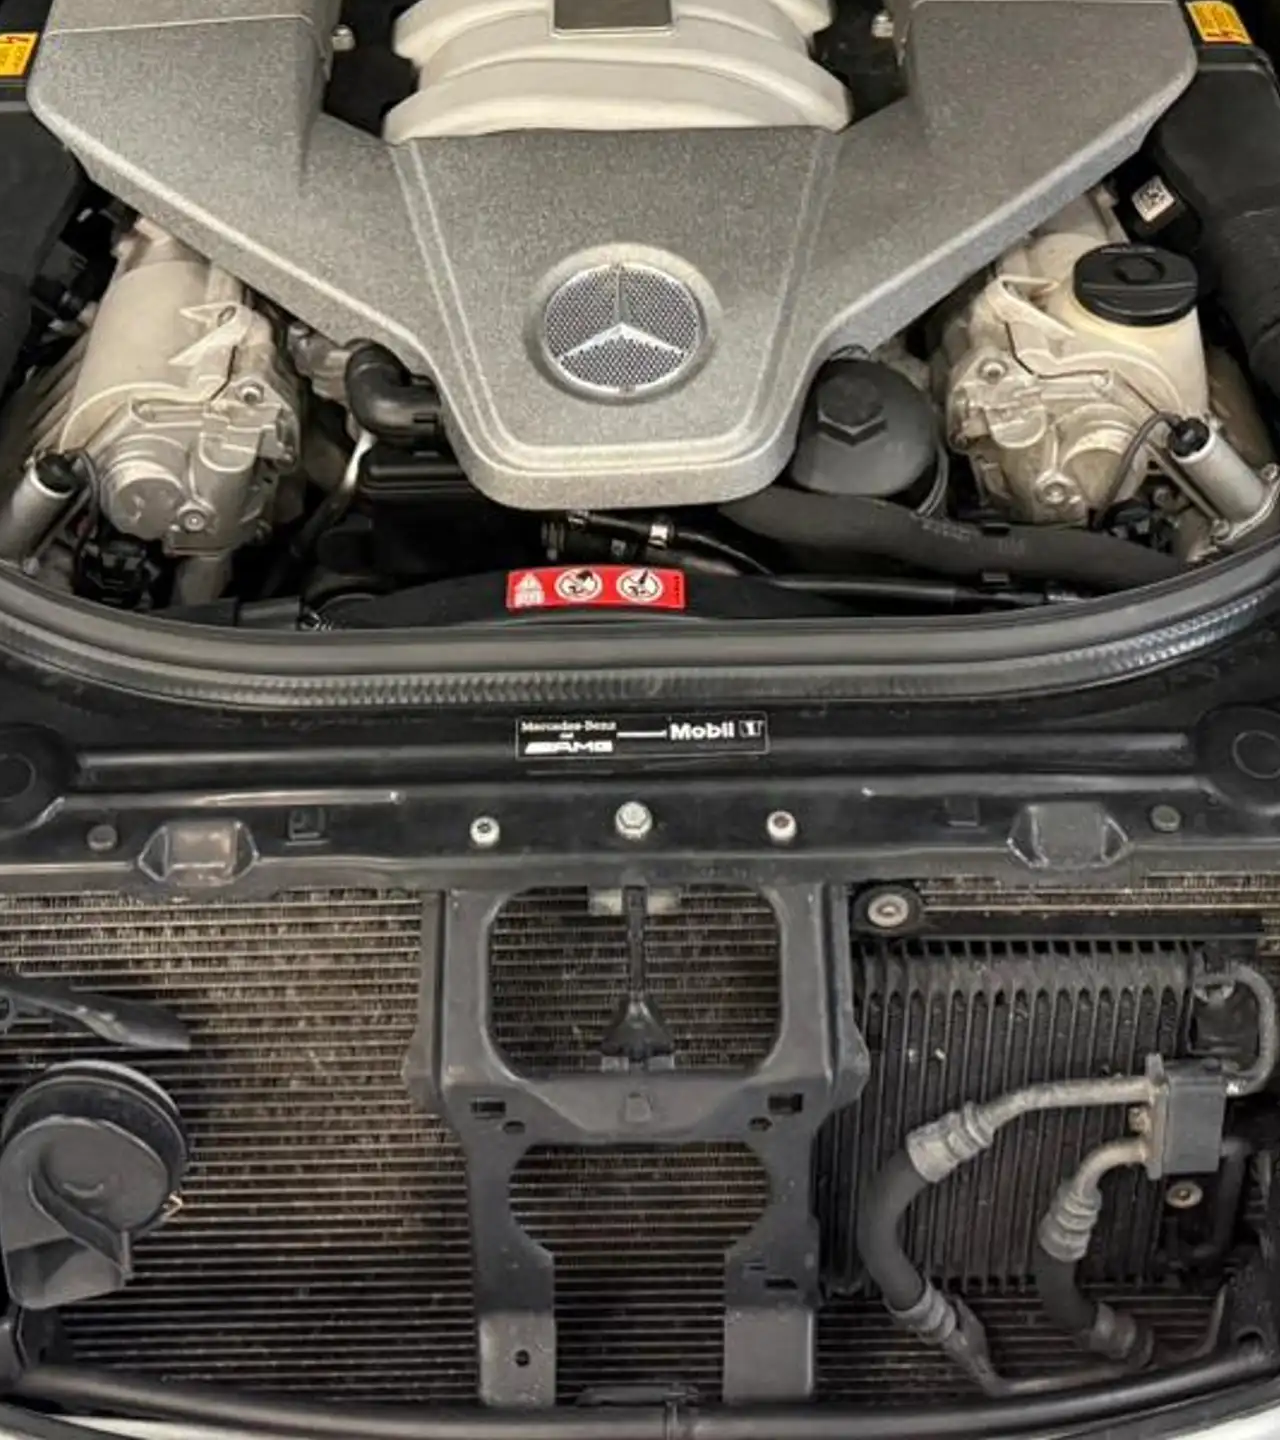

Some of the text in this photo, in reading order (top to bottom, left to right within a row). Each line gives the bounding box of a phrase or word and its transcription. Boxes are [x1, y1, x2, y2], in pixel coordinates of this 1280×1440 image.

[520, 719, 617, 733] Mercedes-Benz
[669, 721, 735, 741] Mobil
[534, 740, 614, 754] AMG
